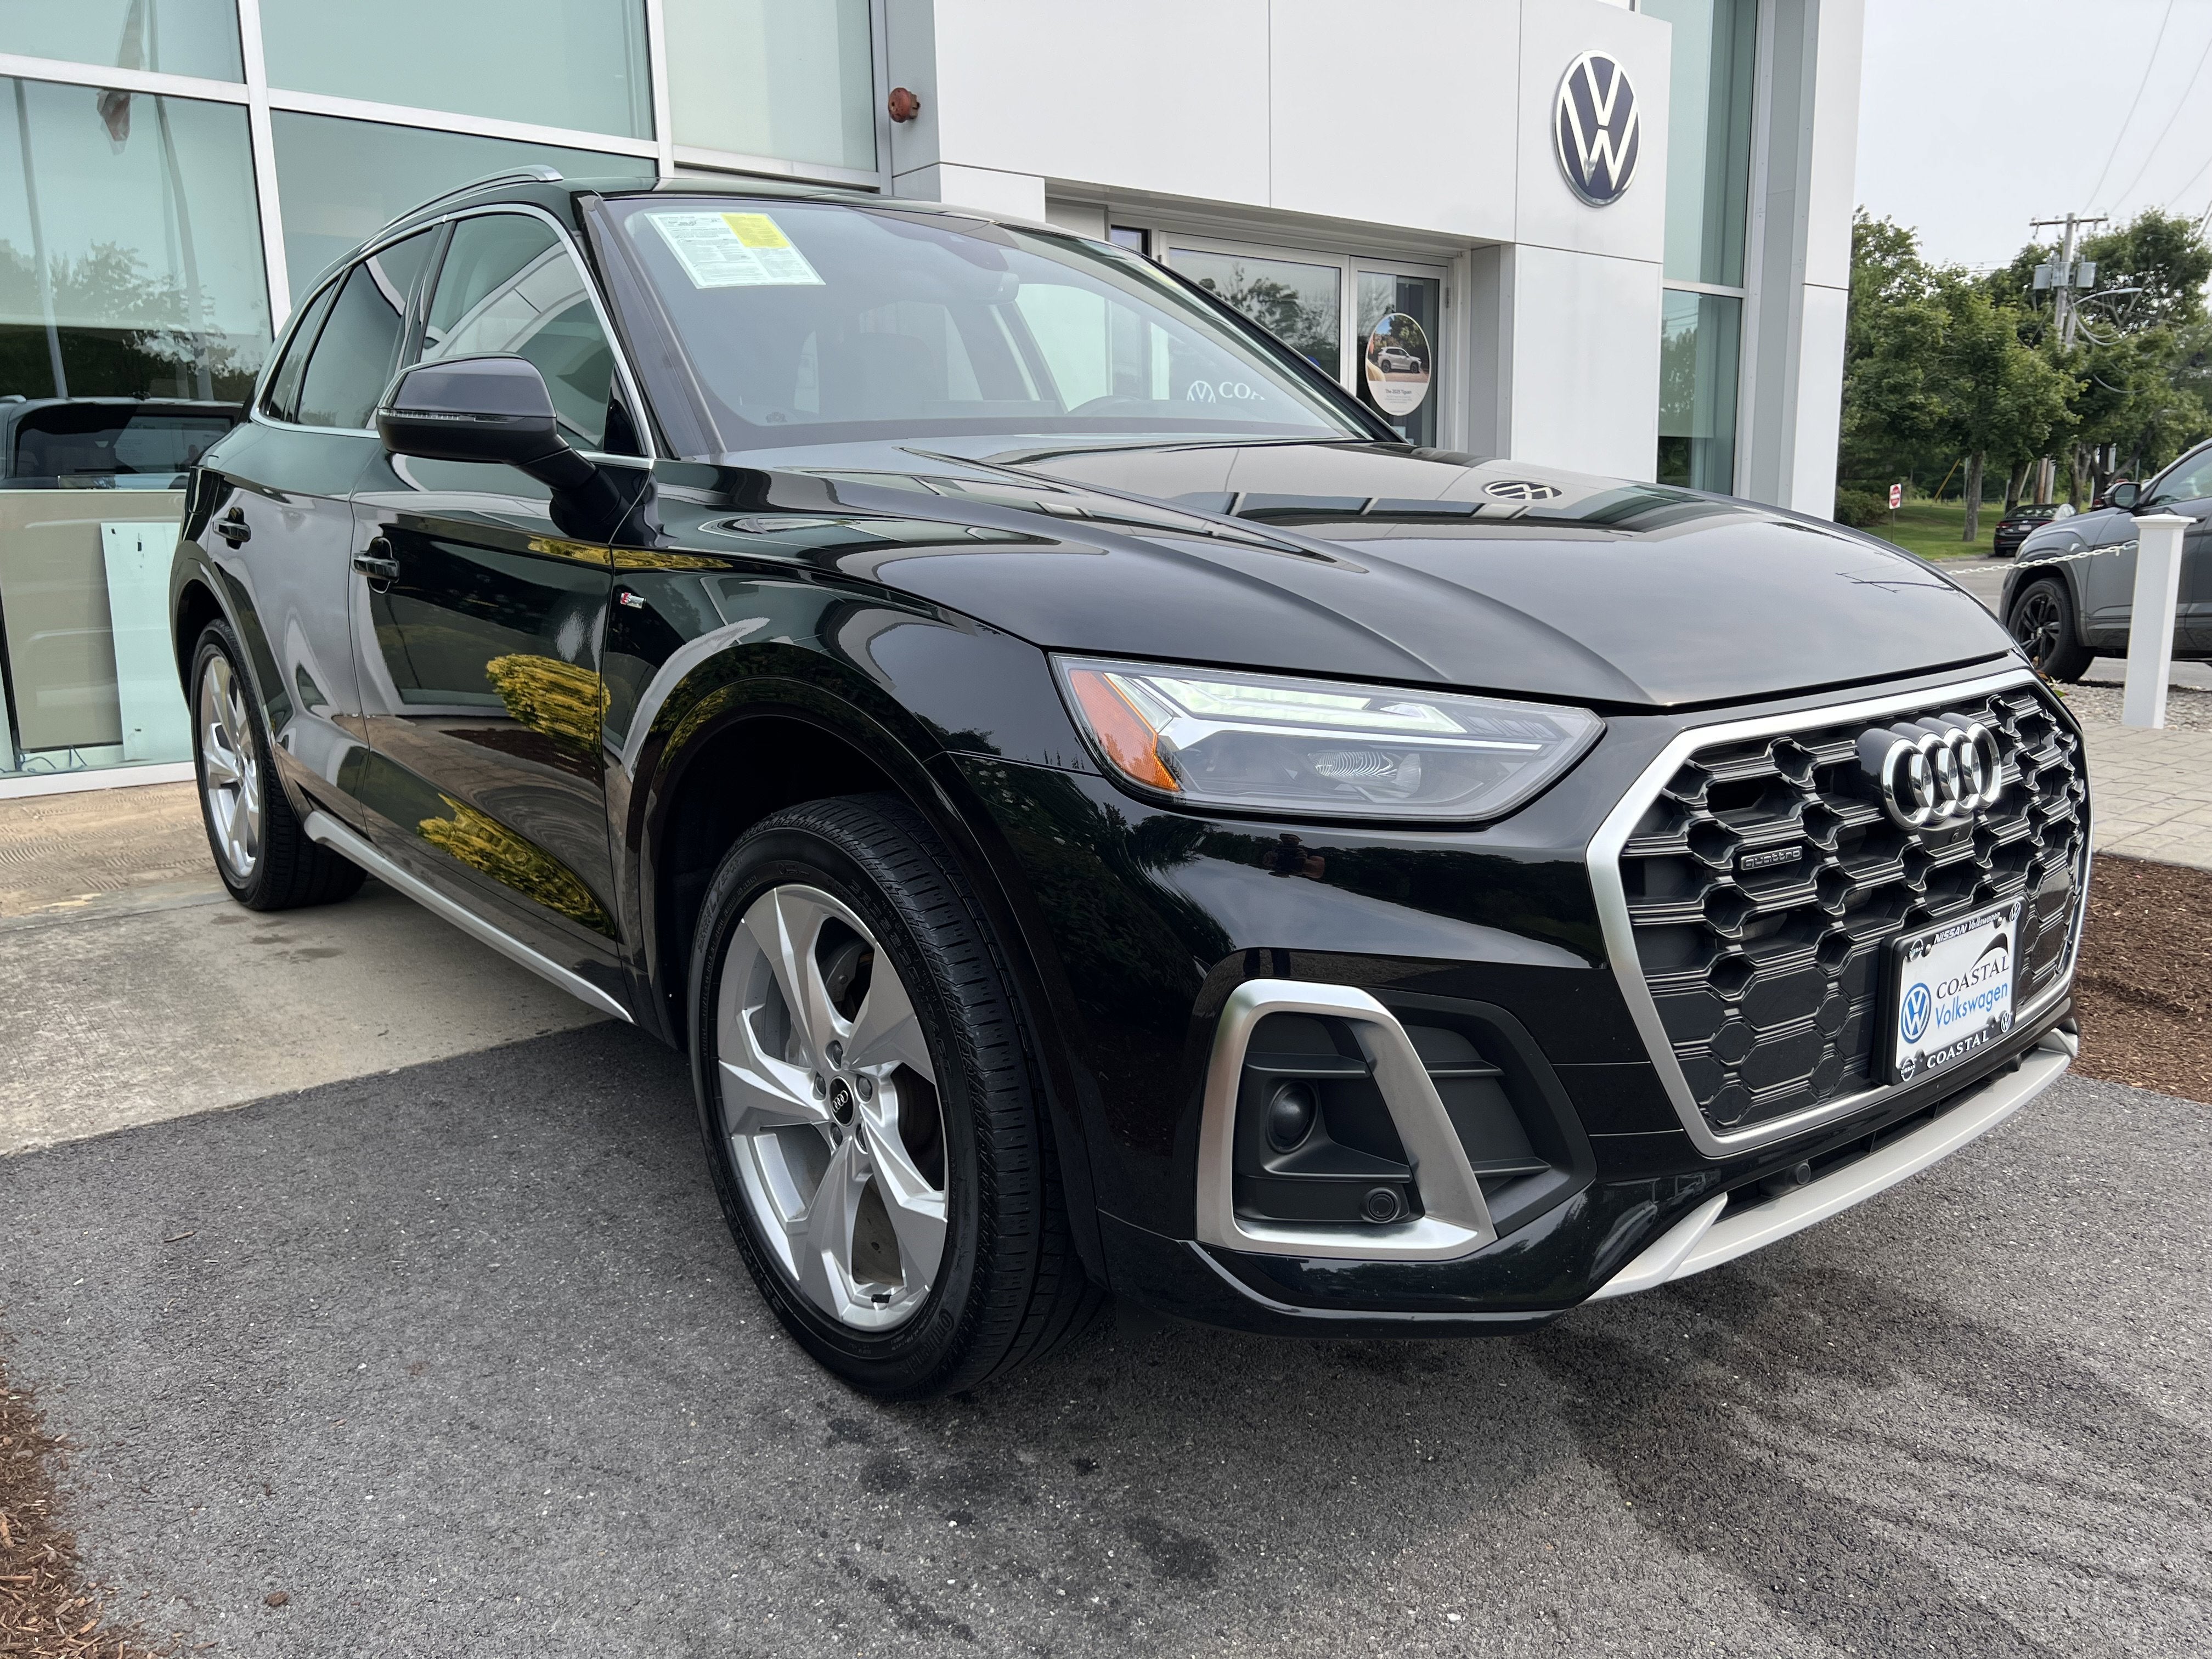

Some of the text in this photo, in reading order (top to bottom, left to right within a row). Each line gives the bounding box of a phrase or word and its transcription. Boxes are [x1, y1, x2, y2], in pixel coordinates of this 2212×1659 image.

[1556, 52, 1641, 203] VW
[1745, 850, 1801, 867] quattro
[1934, 911, 2001, 945] NISSAN Volkswagen
[1936, 955, 2009, 999] COASTAL
[1901, 984, 1931, 1042] VW
[1935, 982, 2008, 1029] Volkswagen
[1926, 1029, 1990, 1069] COASTAL
